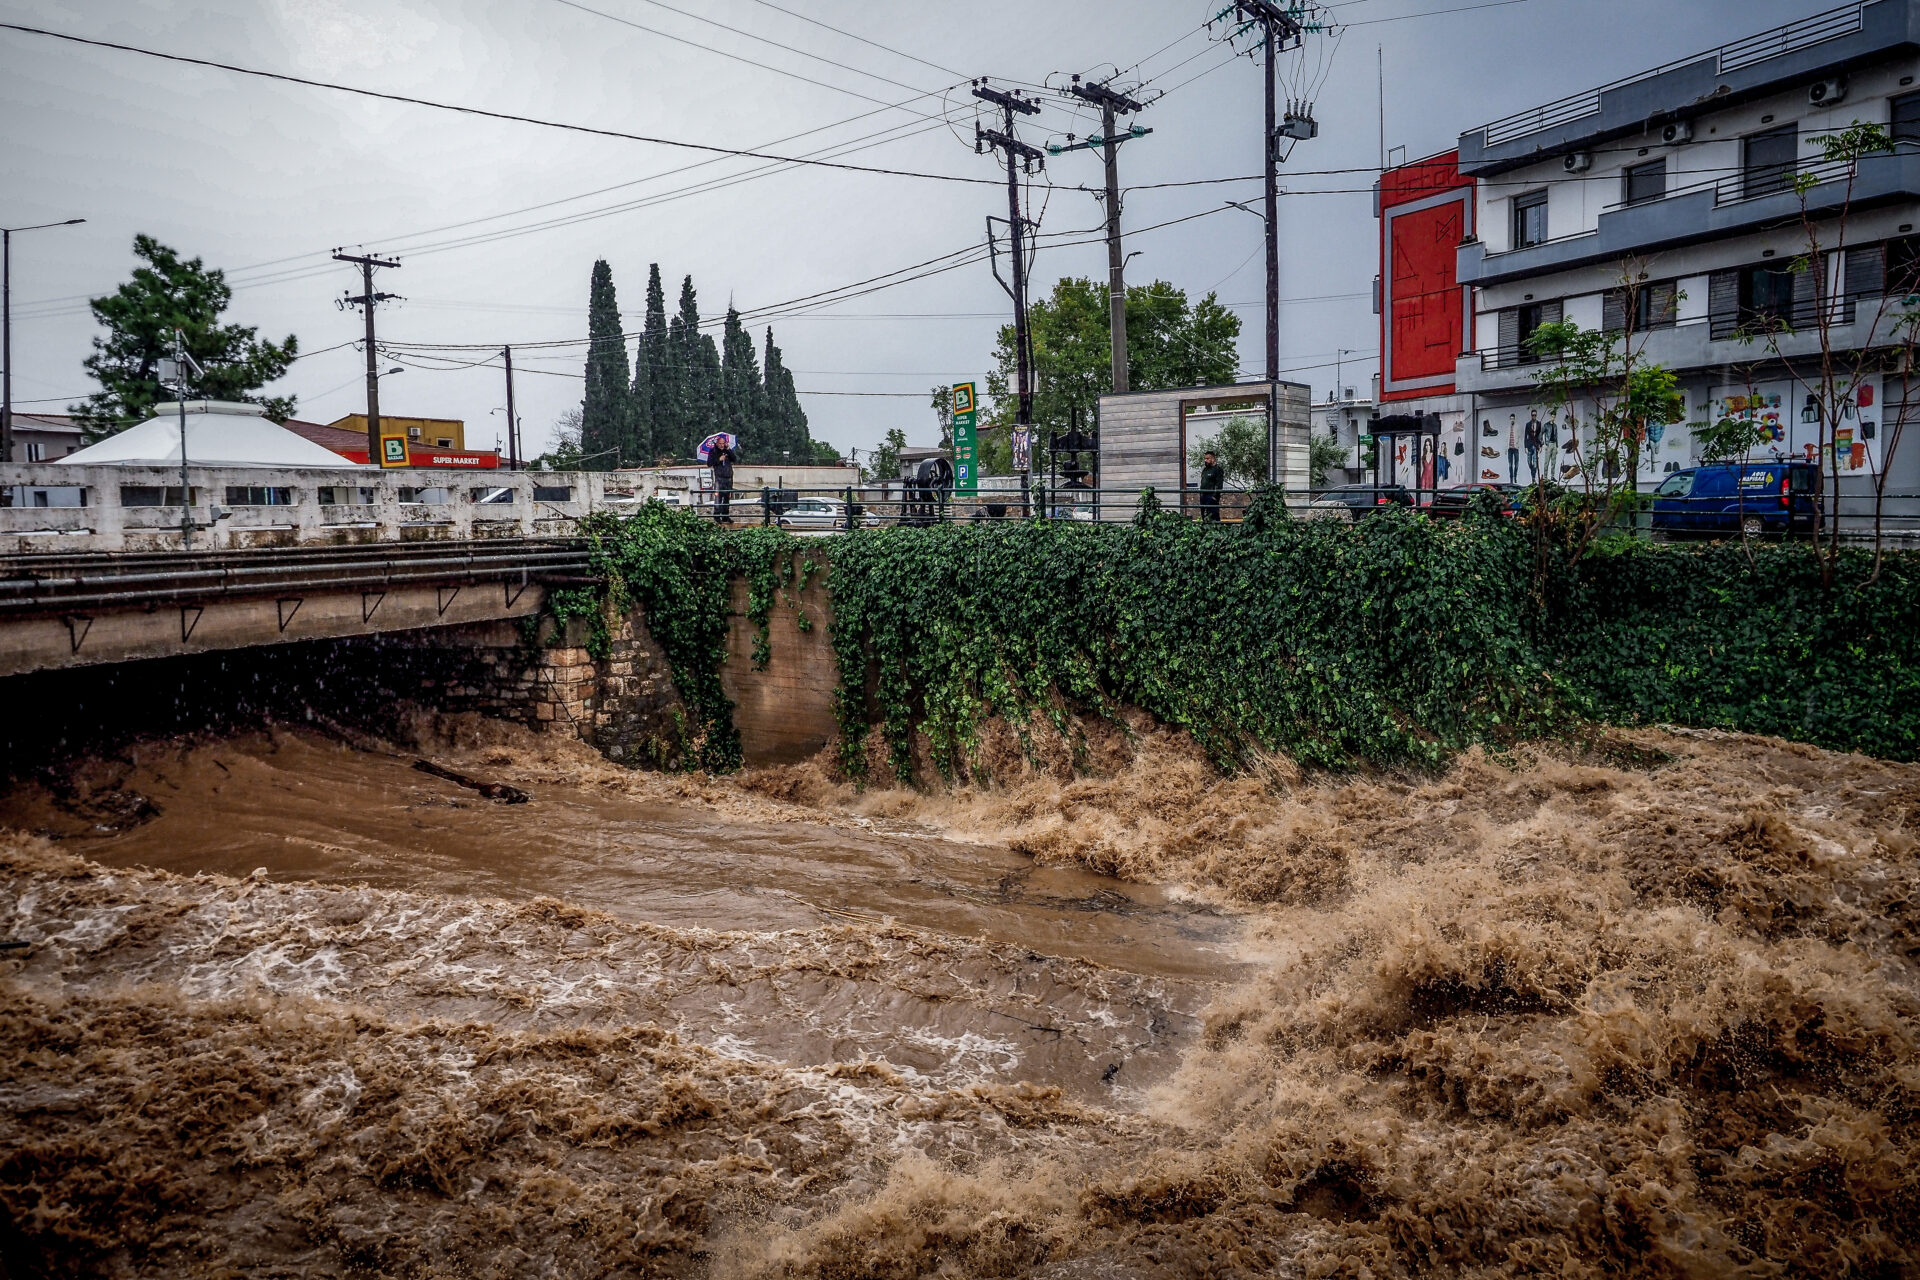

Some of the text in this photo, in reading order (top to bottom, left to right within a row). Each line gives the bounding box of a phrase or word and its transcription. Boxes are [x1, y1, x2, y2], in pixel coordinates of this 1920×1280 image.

[956, 391, 968, 404] B
[386, 440, 403, 455] B
[433, 456, 479, 465] SUPER MARKET
[960, 467, 966, 477] P
